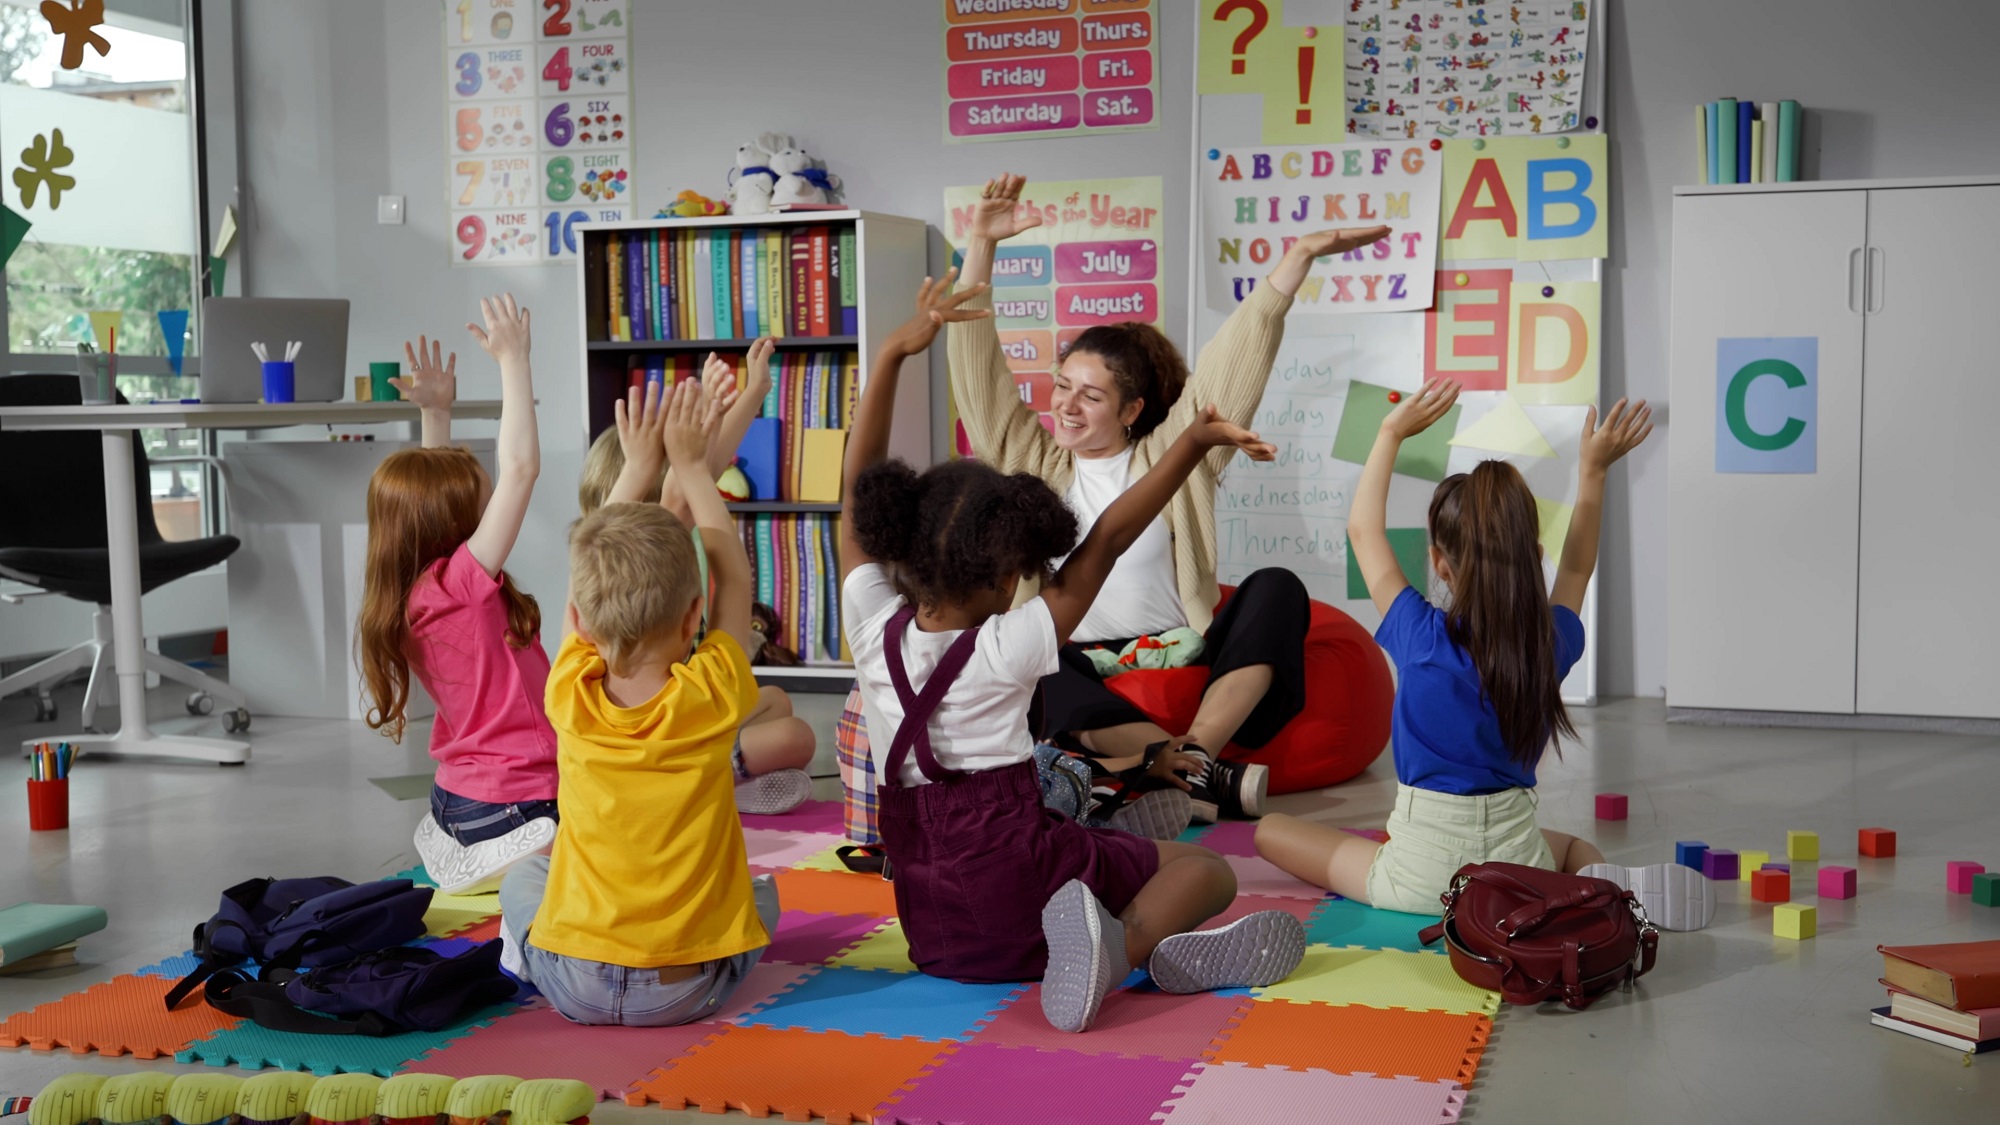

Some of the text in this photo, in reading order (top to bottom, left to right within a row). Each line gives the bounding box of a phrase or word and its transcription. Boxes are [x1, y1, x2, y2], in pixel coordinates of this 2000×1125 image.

[456, 0, 474, 42] 1
[543, 0, 572, 37] 2
[964, 22, 1148, 50] Thursday Thurs.
[455, 49, 523, 97] 3 THREE
[542, 44, 614, 91] 4 FOUR
[981, 59, 1135, 88] Friday Fri.
[456, 105, 523, 152] 5 FIVE
[544, 101, 610, 147] 6 SIX
[968, 95, 1139, 125] Saturday Sat.
[456, 159, 529, 206] 7 SEVEN
[546, 155, 620, 202] 8 EIGHT
[1218, 147, 1425, 181] A B C D E F G
[600, 210, 621, 222] TEN
[1062, 208, 1087, 223] the
[1065, 192, 1080, 206] of
[1089, 193, 1158, 230] Year
[1234, 191, 1411, 224] H I J K L M
[457, 213, 527, 260] 9 NINE
[951, 200, 1058, 239] Mths
[831, 245, 840, 278] LAW
[1081, 251, 1131, 276] July
[1218, 238, 1242, 265] N
[1249, 238, 1271, 264] O
[1372, 234, 1392, 260] S
[1401, 232, 1421, 259] T
[717, 273, 726, 323] SURGERY
[797, 266, 808, 331] Big Book
[814, 236, 825, 324] WORLD HISTORY
[1330, 275, 1355, 302] X
[1360, 274, 1384, 301] Y
[1387, 273, 1407, 300] Z
[1069, 292, 1144, 316] August
[1725, 358, 1808, 451] C
[1221, 484, 1344, 509] Wednesday
